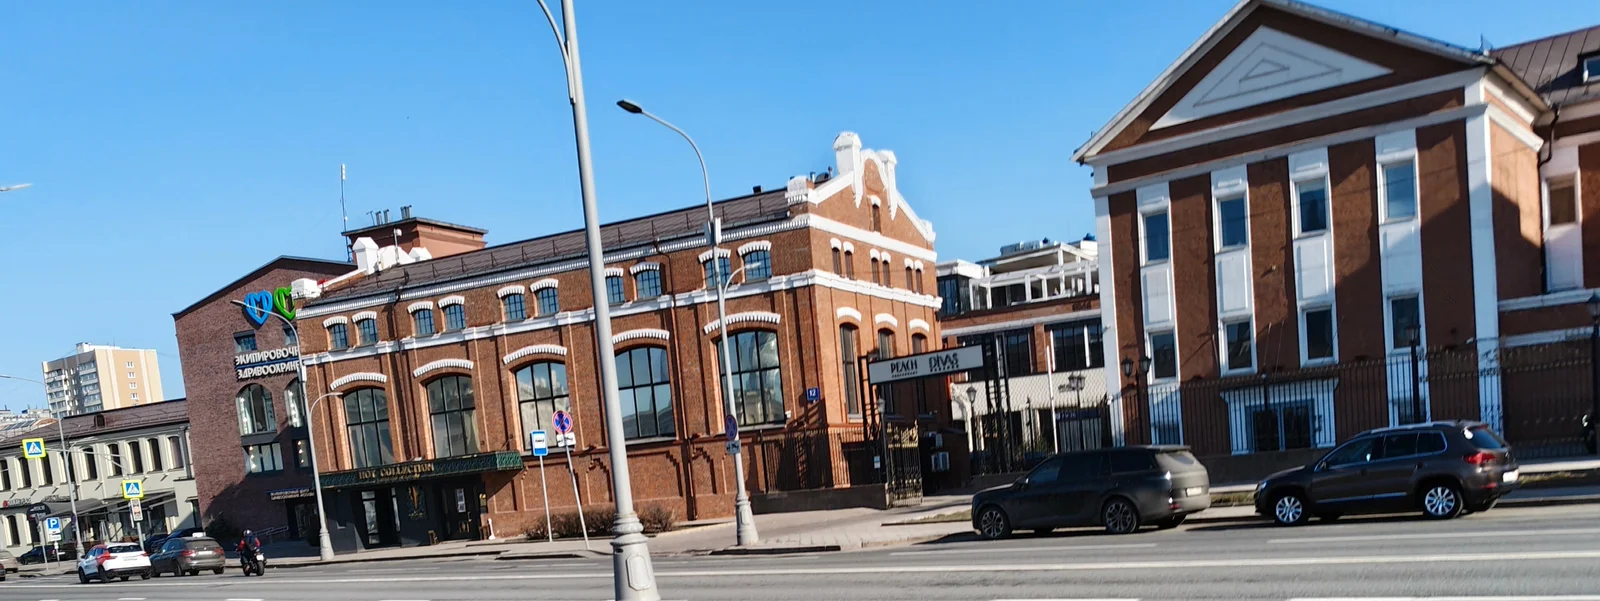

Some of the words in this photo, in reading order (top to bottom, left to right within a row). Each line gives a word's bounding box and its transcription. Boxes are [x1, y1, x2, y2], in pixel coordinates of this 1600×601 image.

[890, 359, 918, 373] PEACH
[359, 470, 376, 480] HOT
[380, 463, 434, 477] COLLECTION
